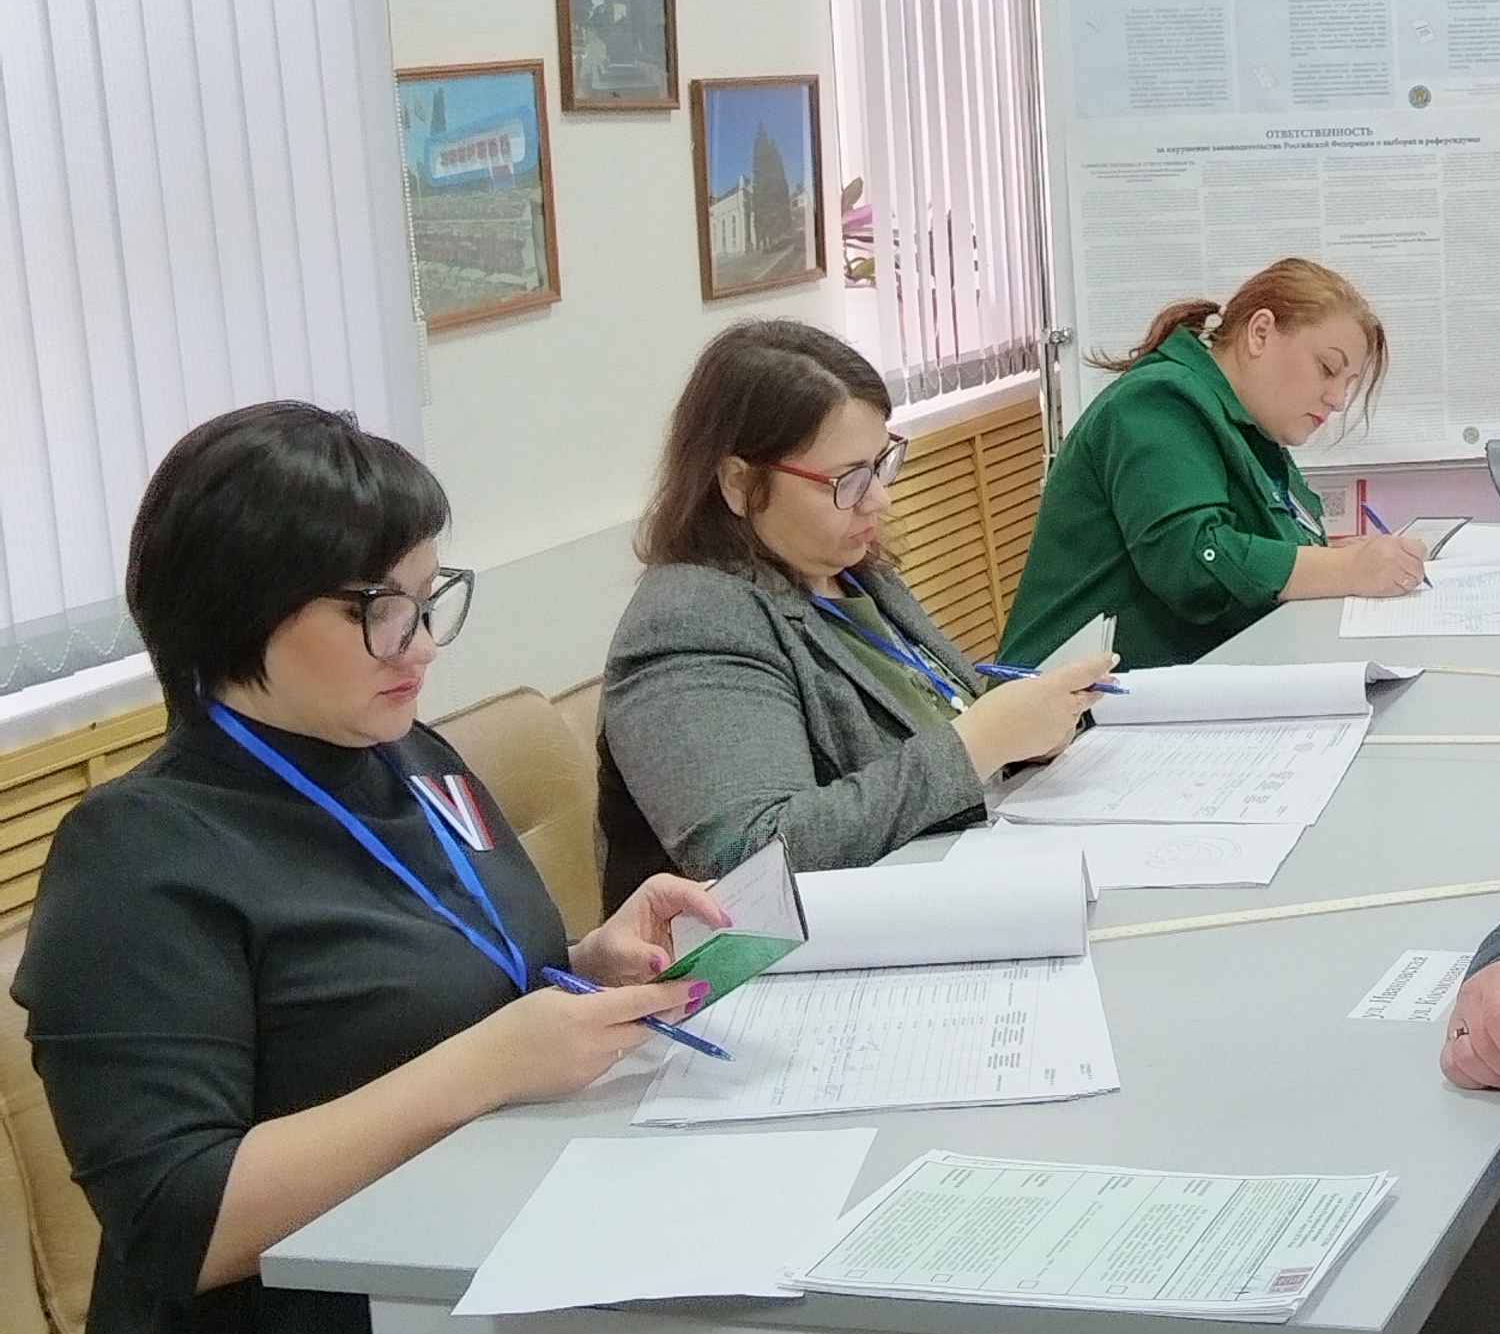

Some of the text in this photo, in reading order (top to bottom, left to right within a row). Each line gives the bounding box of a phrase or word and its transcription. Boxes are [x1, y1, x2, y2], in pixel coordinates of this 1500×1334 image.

[1166, 146, 1210, 155] нарушение
[1212, 142, 1281, 152] законодательства
[1283, 140, 1329, 150] Российской
[1331, 139, 1375, 149] Федерации
[1383, 138, 1417, 147] выборах
[1425, 137, 1481, 147] референдумах
[1266, 127, 1373, 139] ОТВЕТСТВЕННОСТЬ
[1362, 956, 1429, 1019] ул. Ивановская
[1408, 954, 1473, 1021] ул. Космонавтов
